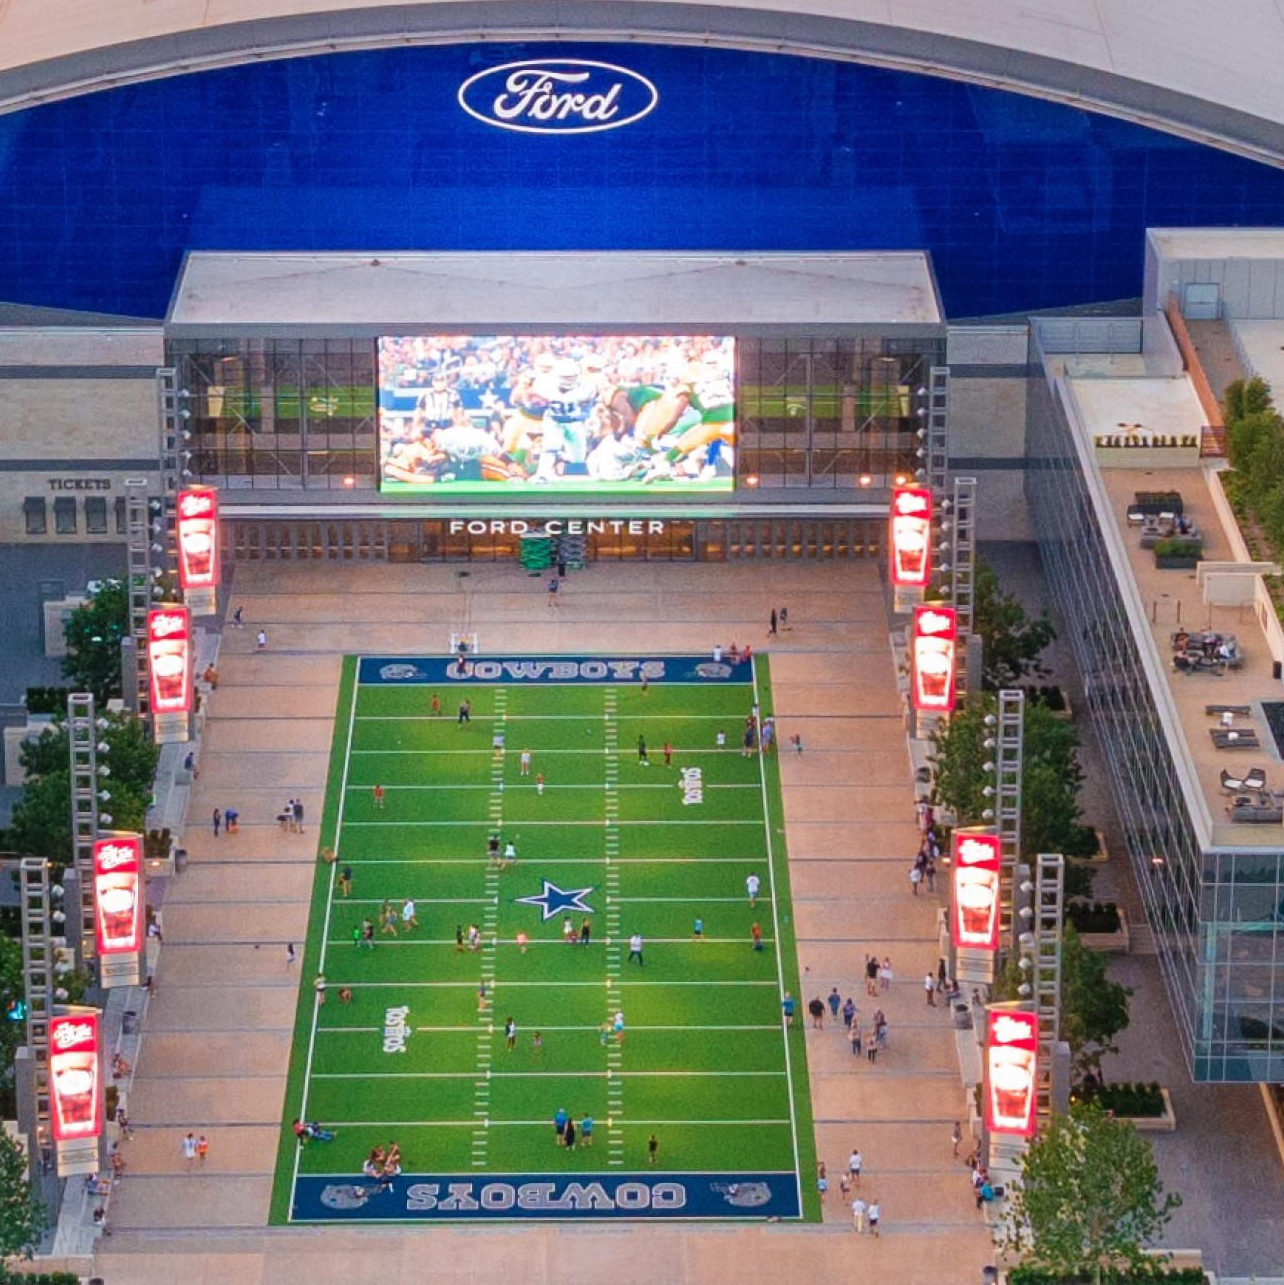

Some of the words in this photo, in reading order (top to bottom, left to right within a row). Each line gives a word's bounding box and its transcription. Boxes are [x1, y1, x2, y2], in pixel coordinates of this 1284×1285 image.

[493, 69, 623, 120] Ford
[48, 478, 111, 491] TICKETS
[450, 520, 528, 535] FORD
[545, 520, 664, 535] CENTER
[446, 661, 665, 680] COWBOYS
[406, 1182, 687, 1212] COWBOYS
